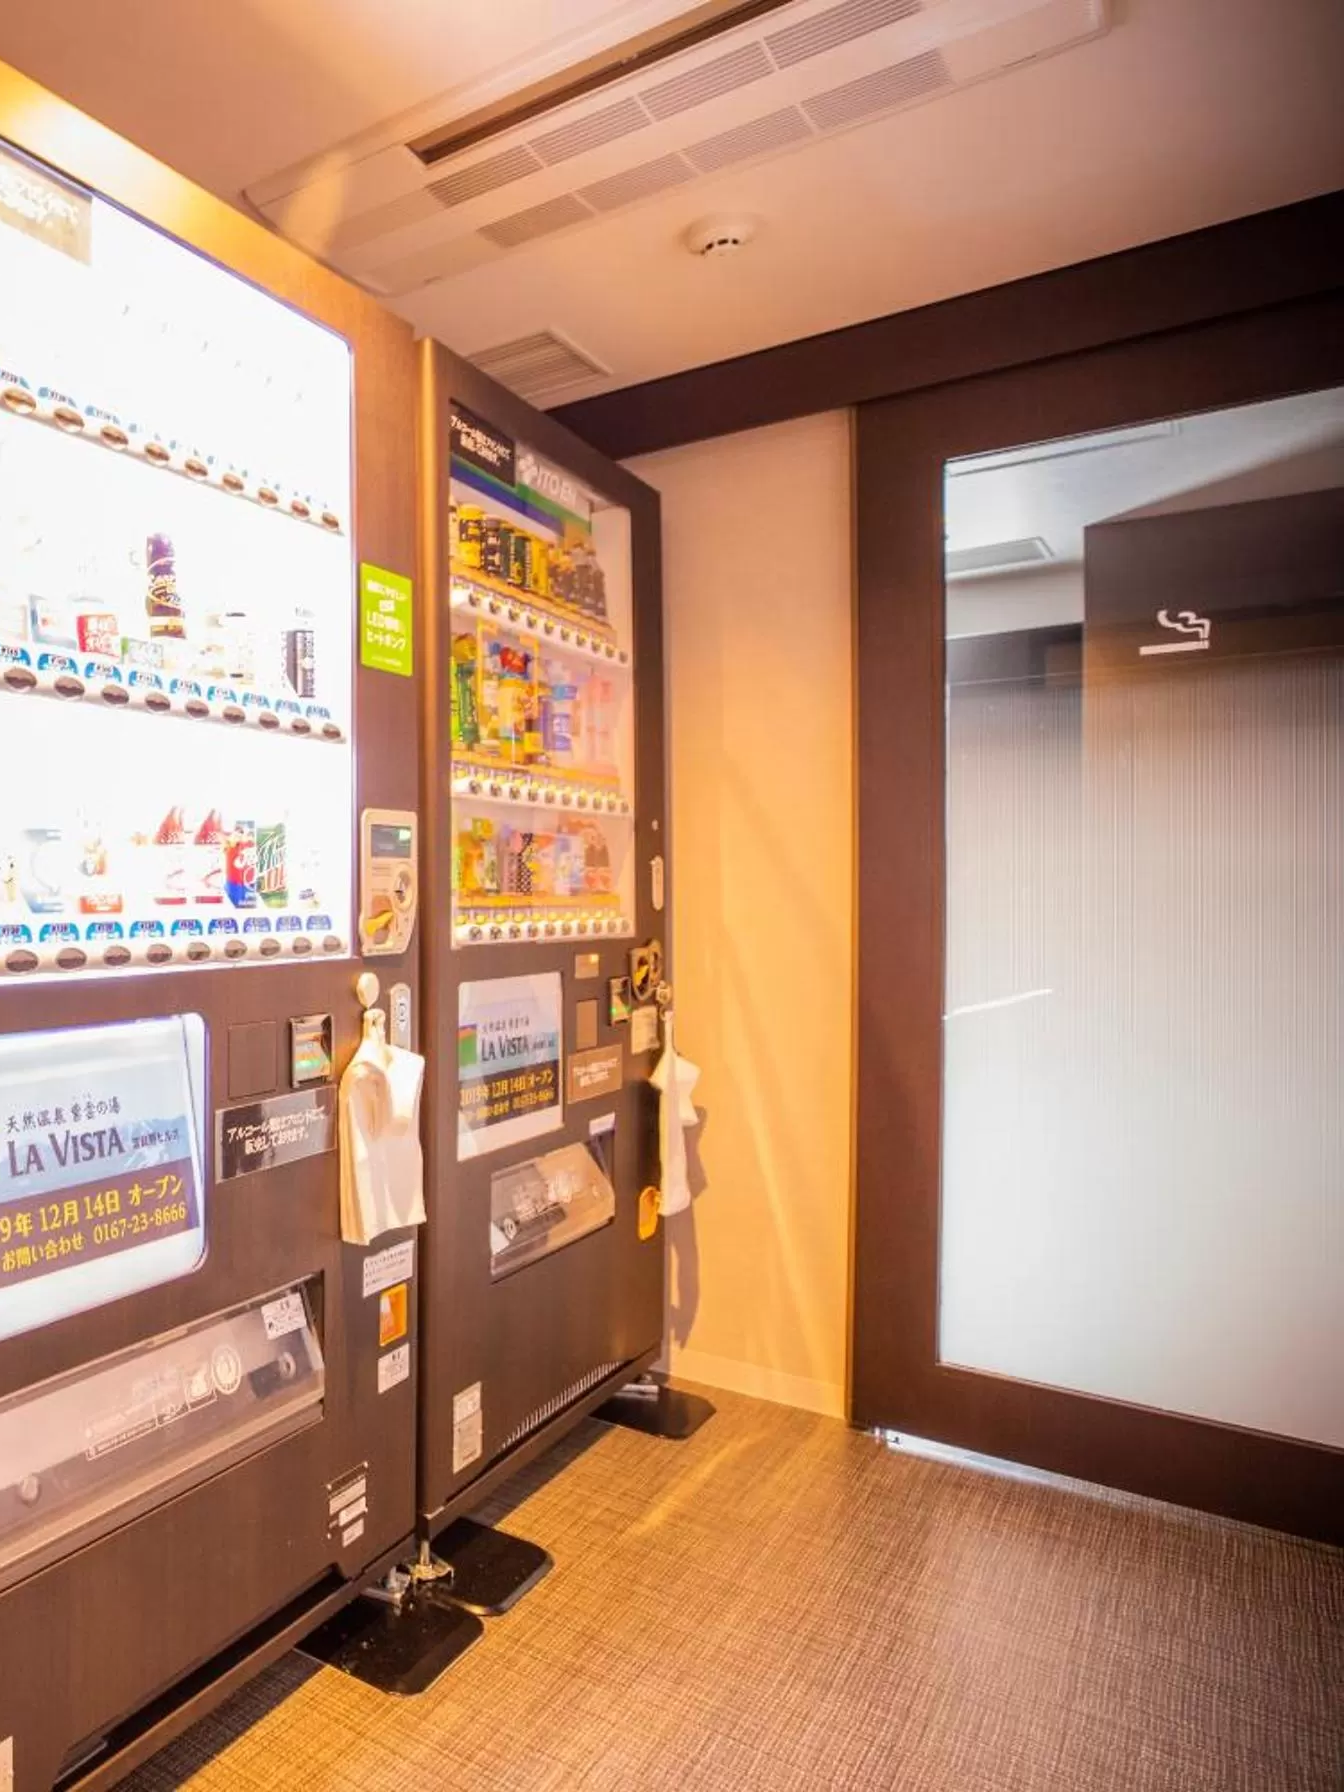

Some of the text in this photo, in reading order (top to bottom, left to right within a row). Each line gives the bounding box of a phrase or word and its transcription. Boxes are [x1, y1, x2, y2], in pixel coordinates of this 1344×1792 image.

[481, 1038, 496, 1061] LA
[7, 1126, 126, 1178] LA VISTA
[40, 1199, 79, 1232] 12月
[85, 1190, 121, 1219] 14日
[127, 1174, 184, 1206] オープン
[93, 1202, 187, 1244] 0167-23-8666
